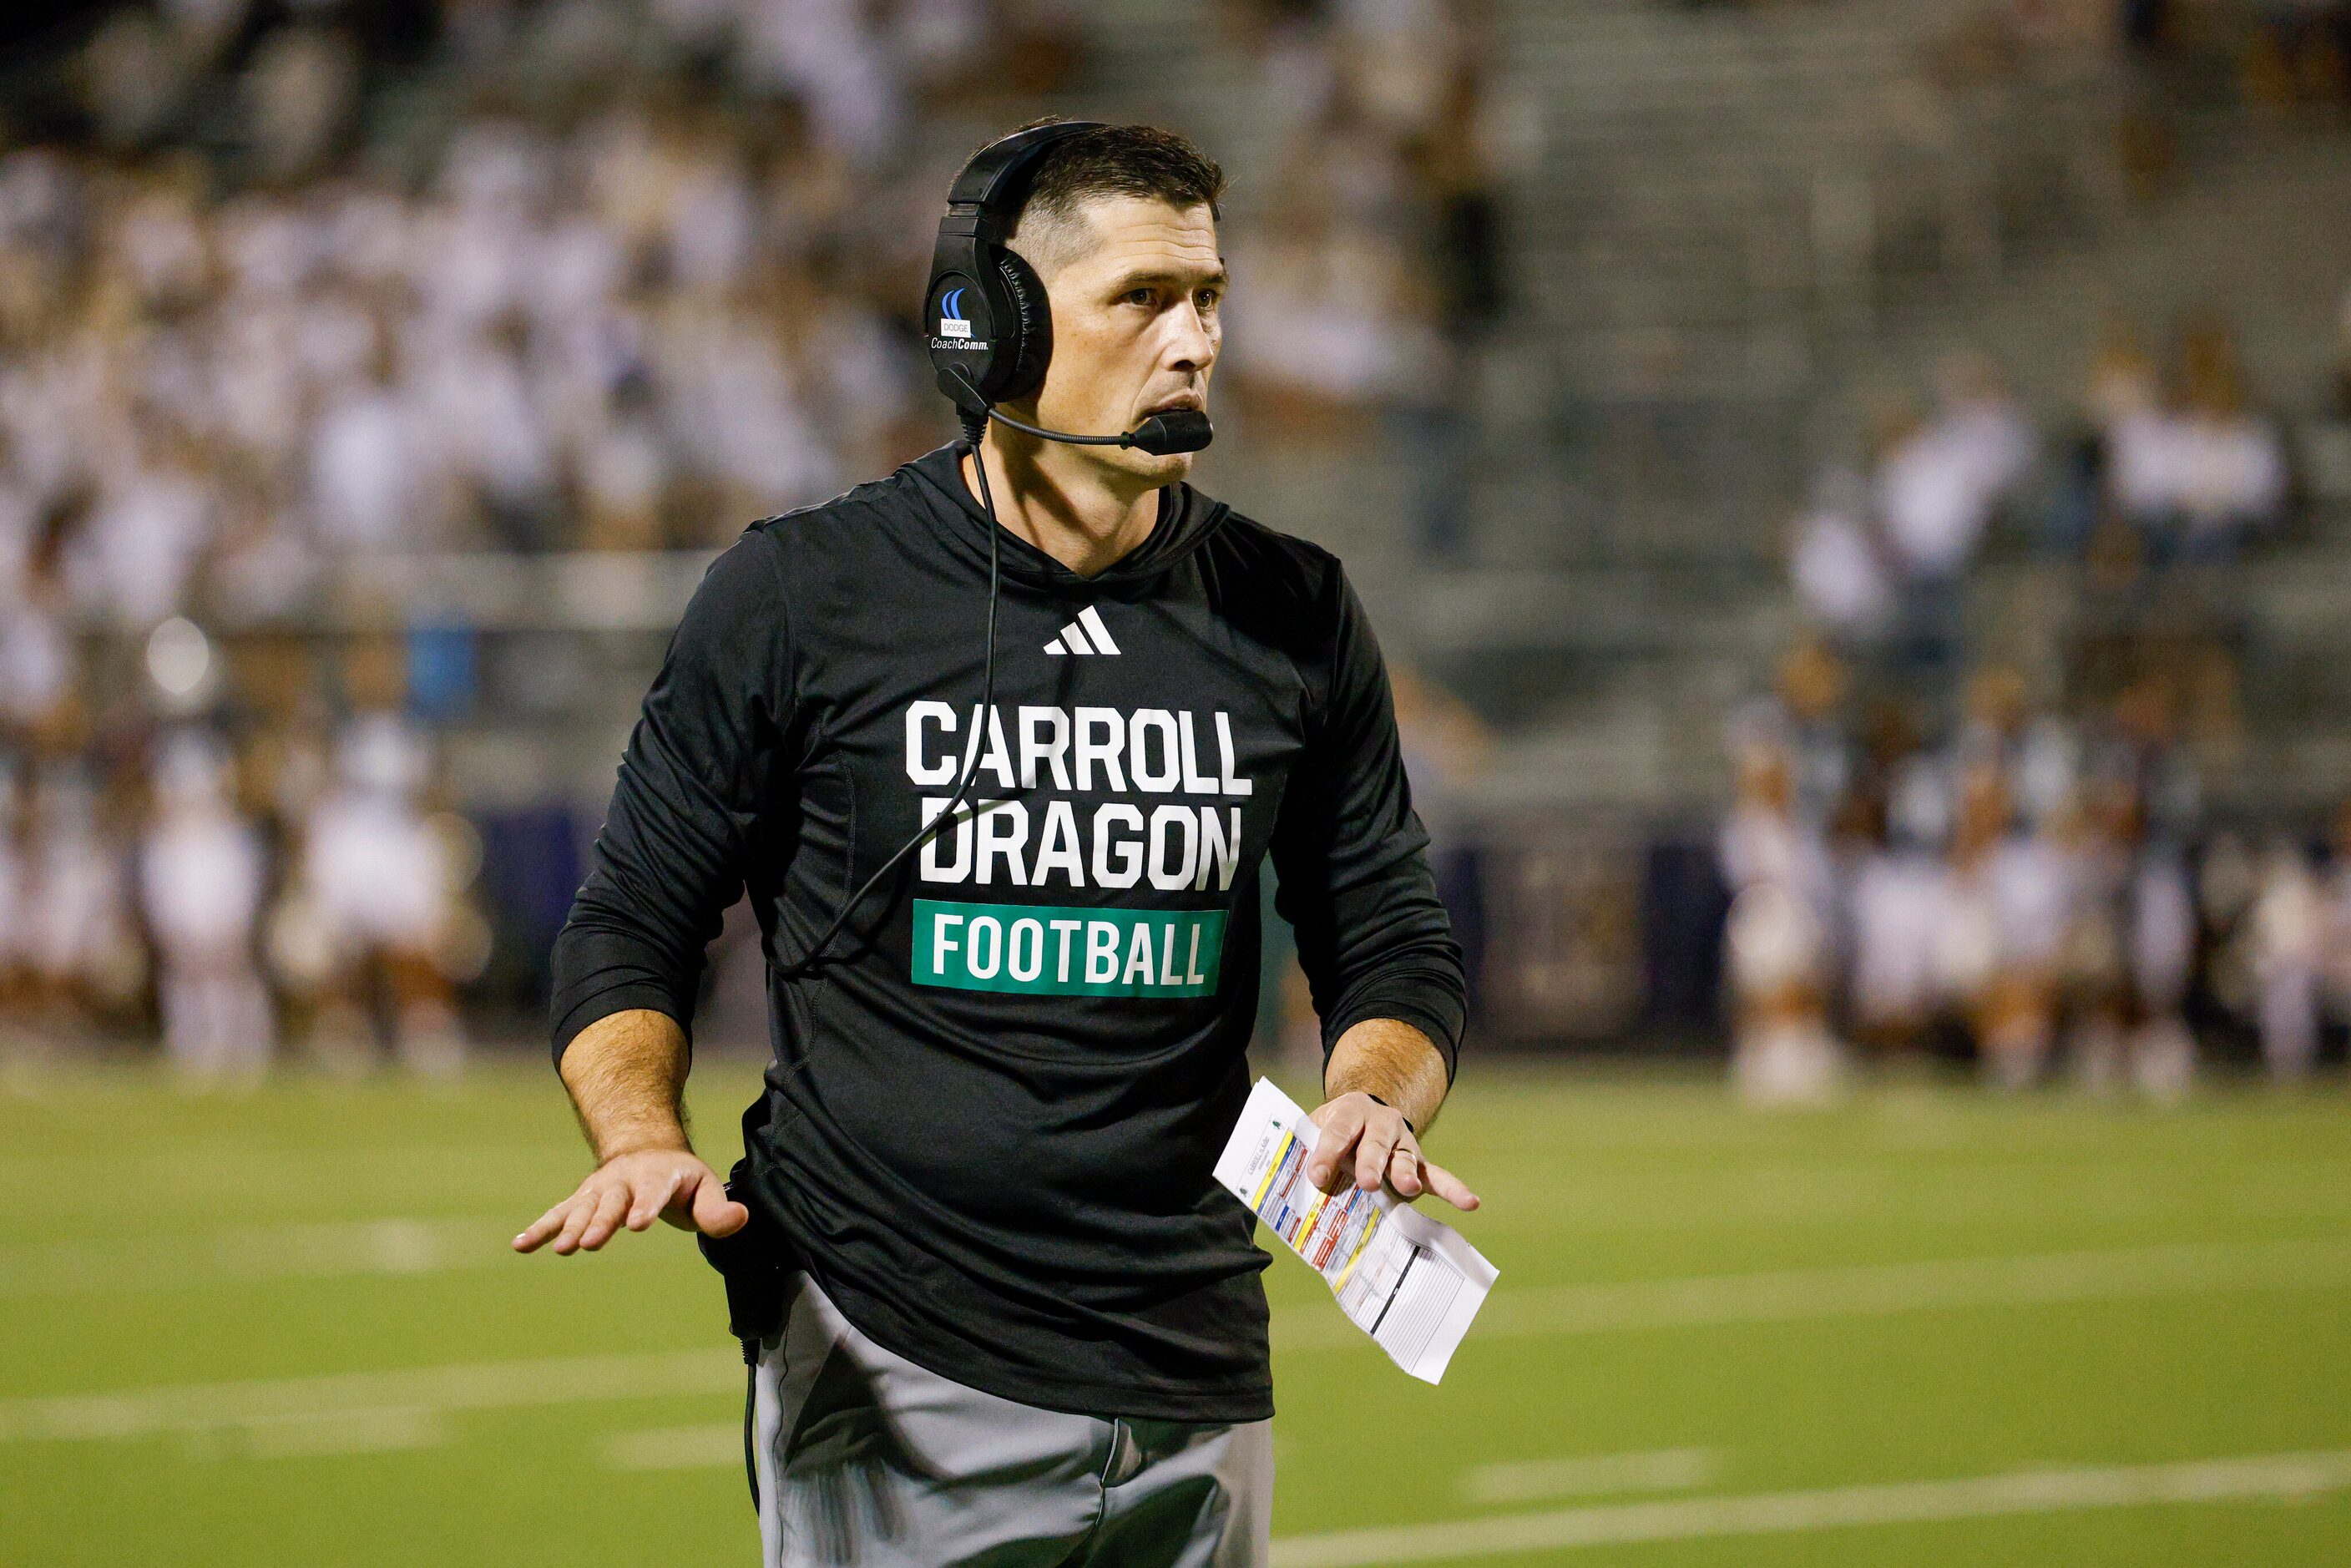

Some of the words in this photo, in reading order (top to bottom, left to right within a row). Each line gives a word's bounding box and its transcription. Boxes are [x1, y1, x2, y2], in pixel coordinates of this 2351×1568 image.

[943, 323, 968, 332] DODGE
[906, 700, 1252, 796] CARROLL
[920, 797, 1241, 892] DRAGON
[933, 913, 1205, 986] FOOTBALL
